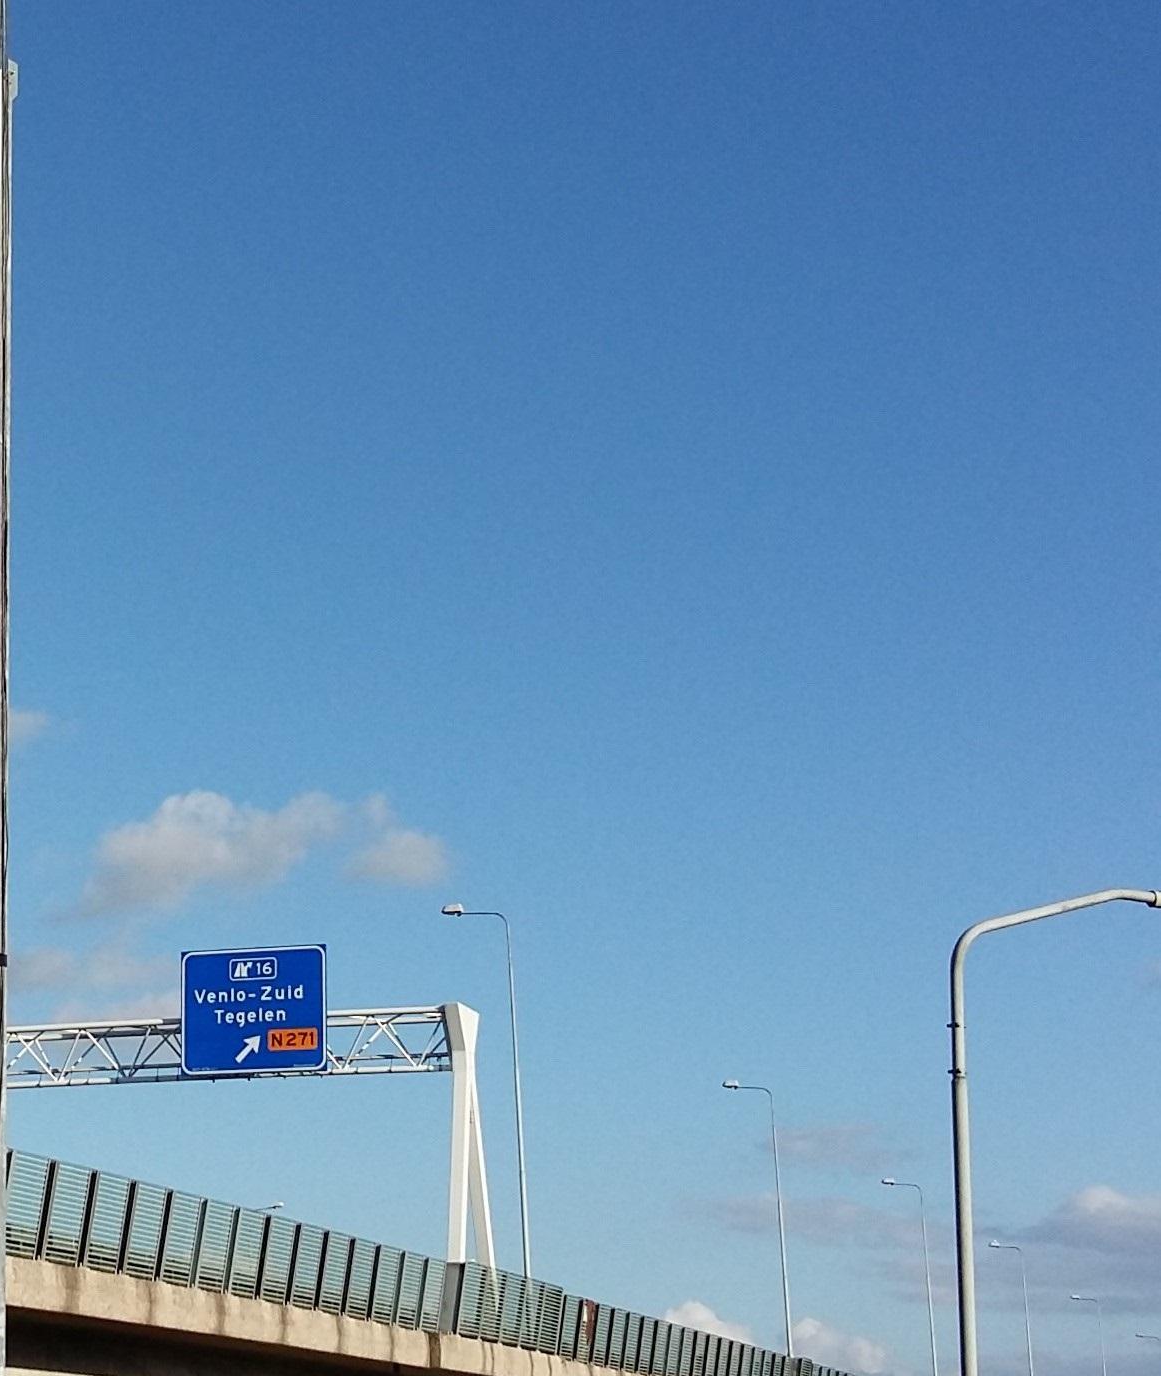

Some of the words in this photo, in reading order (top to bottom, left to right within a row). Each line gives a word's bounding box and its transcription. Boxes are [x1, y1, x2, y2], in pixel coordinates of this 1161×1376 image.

[257, 962, 273, 975] 16
[194, 984, 304, 1004] Venlo-Zuid
[214, 1008, 286, 1028] Tegelen
[271, 1032, 315, 1047] N271
